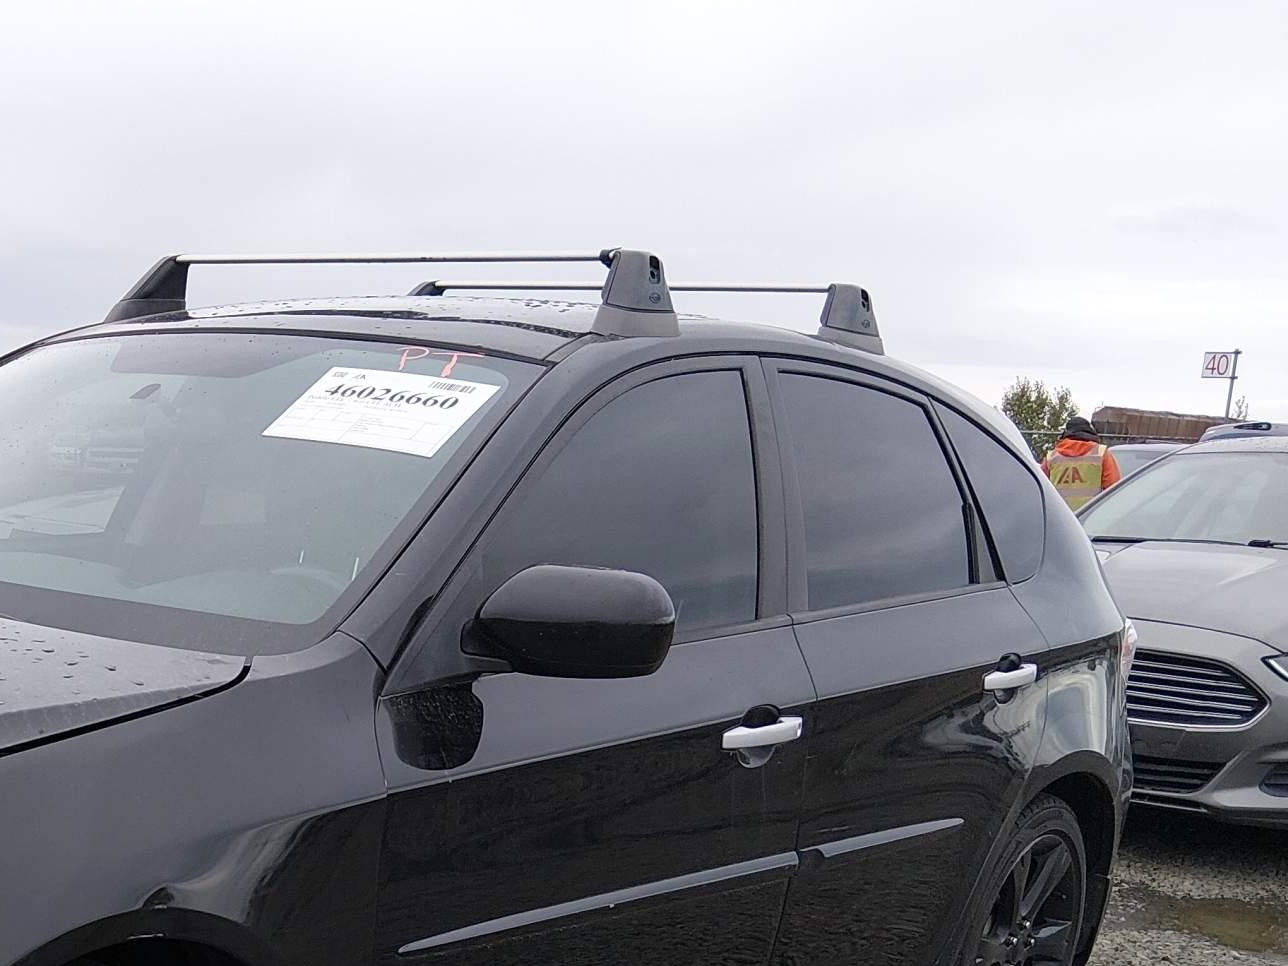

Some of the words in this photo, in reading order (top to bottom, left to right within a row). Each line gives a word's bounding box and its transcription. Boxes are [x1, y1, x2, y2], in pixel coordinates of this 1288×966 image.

[397, 346, 486, 378] PT
[1205, 354, 1229, 376] 40
[325, 383, 460, 410] 46026660
